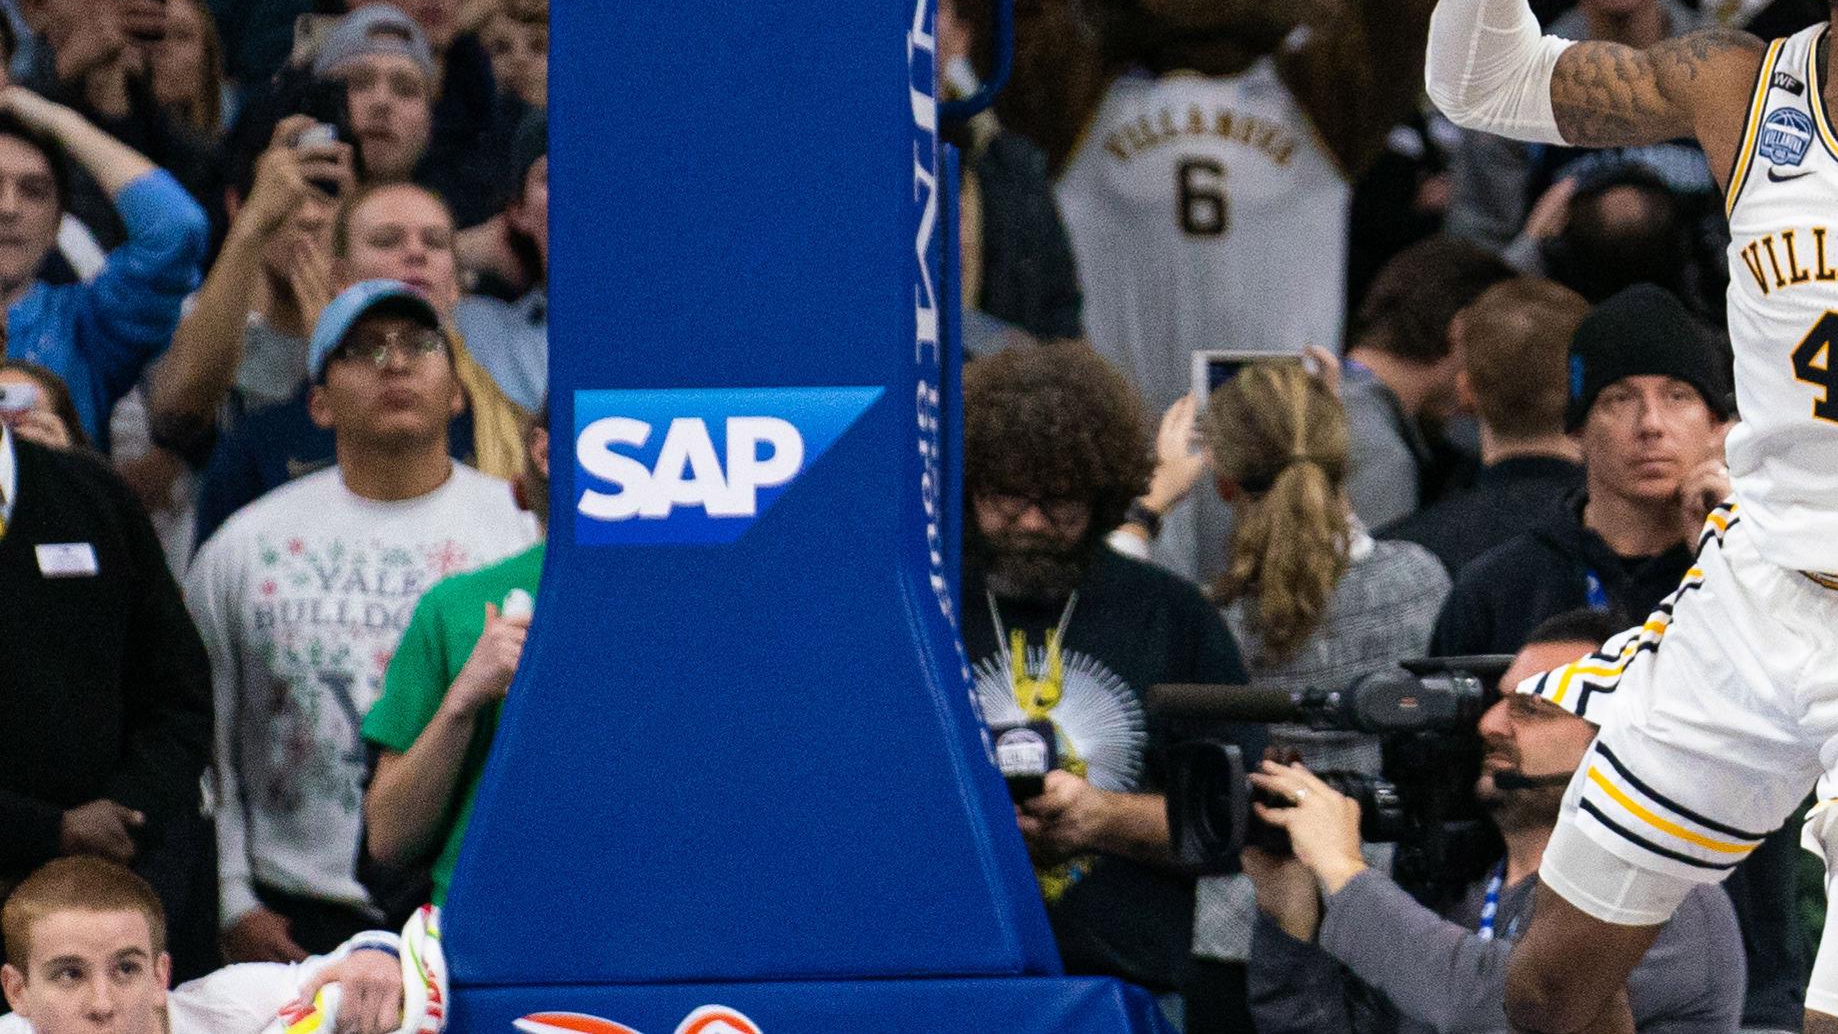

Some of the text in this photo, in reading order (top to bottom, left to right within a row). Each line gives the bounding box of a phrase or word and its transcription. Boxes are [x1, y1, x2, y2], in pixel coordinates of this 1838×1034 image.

[1103, 103, 1293, 169] VILLANOVA
[1176, 152, 1232, 241] 6
[576, 416, 805, 522] SAP
[314, 564, 424, 595] YALE
